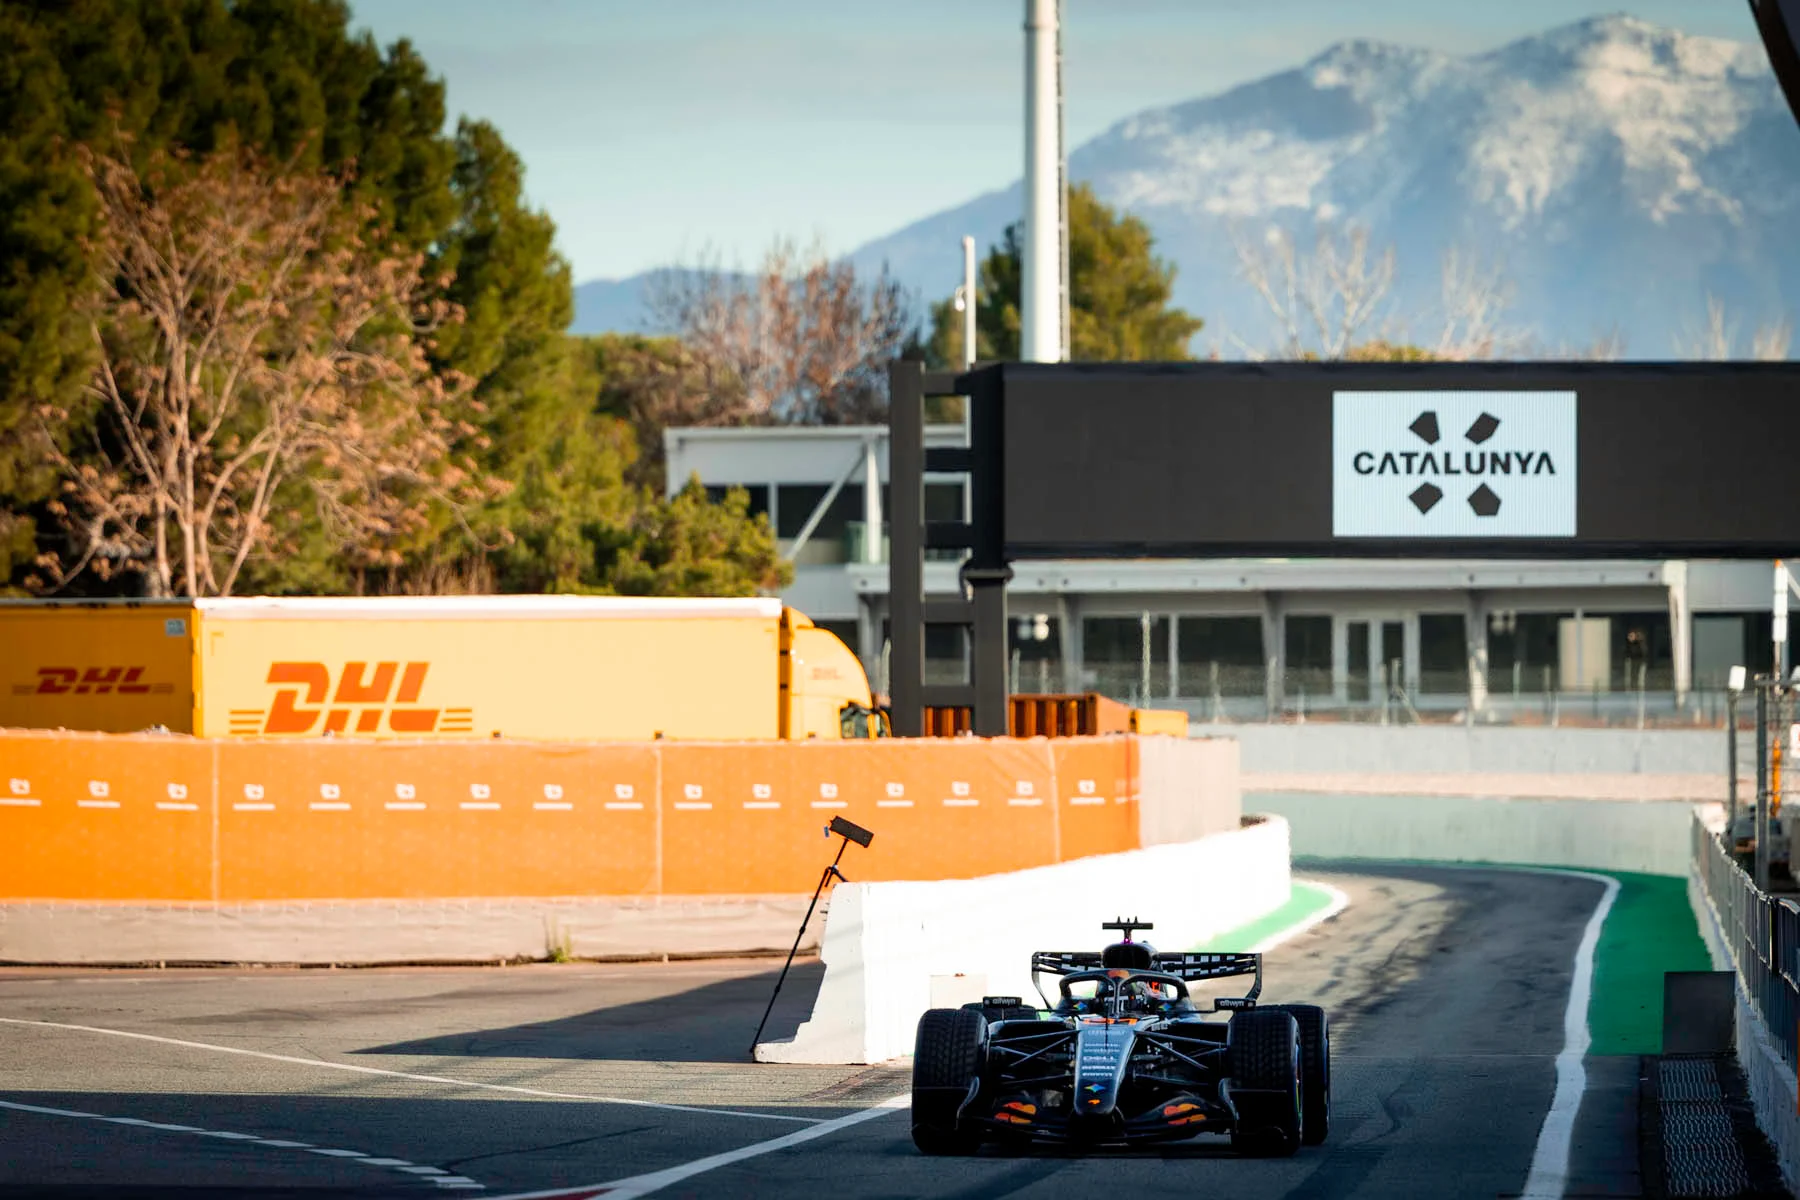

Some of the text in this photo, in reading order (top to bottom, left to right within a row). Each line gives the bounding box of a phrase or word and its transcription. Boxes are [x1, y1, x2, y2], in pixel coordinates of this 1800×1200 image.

[1353, 451, 1556, 475] CATALUNYA
[37, 666, 151, 694] DHL
[263, 661, 441, 734] DHL
